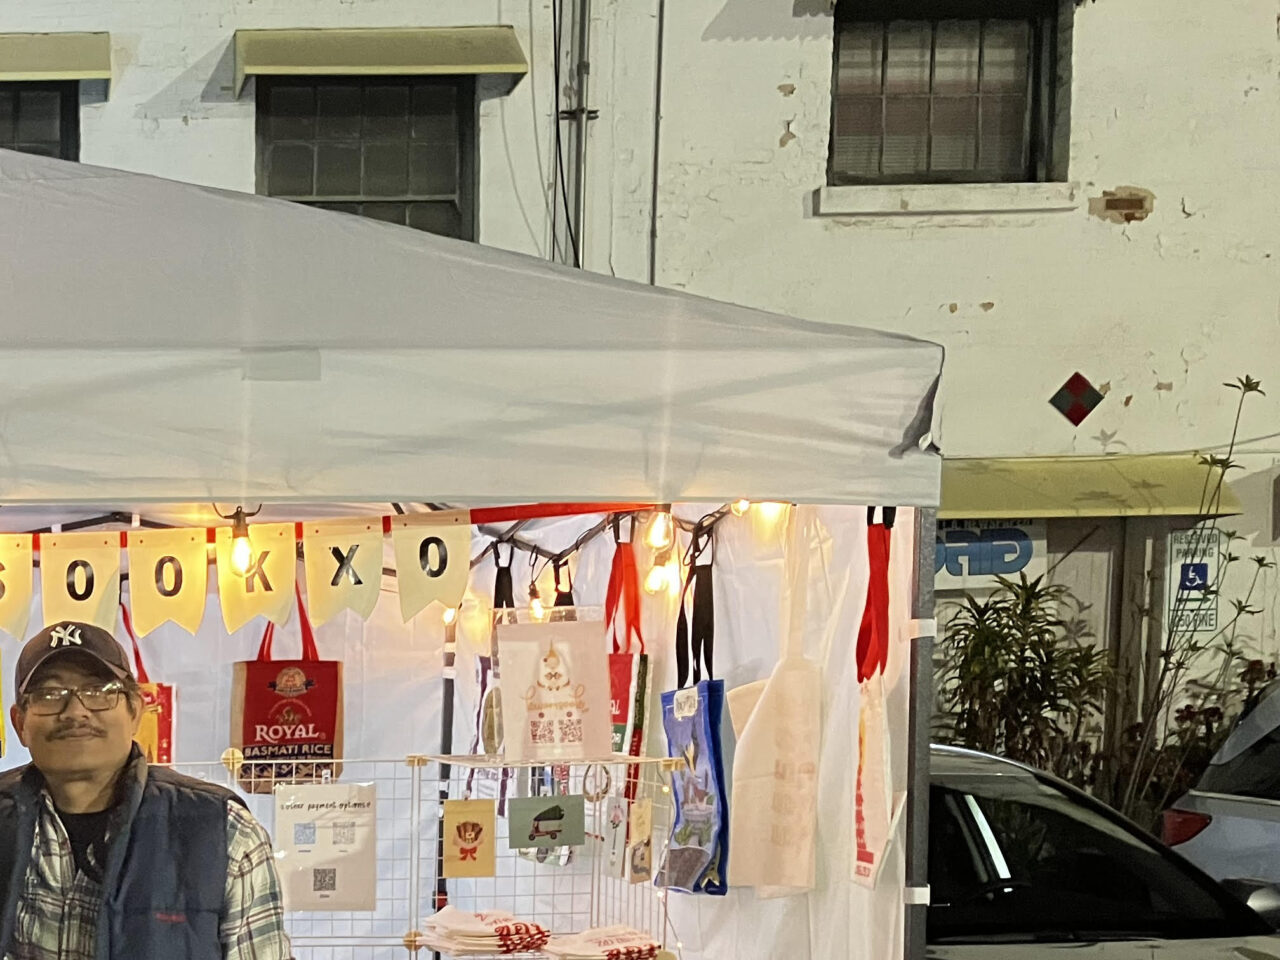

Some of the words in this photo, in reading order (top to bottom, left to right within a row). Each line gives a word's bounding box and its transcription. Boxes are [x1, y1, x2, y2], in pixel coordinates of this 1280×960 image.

[1174, 533, 1218, 544] RESERVED
[1176, 547, 1214, 558] PARKING
[254, 723, 320, 744] ROYAL
[244, 744, 298, 757] BASMATI
[301, 743, 332, 754] RICE
[307, 801, 336, 812] payment
